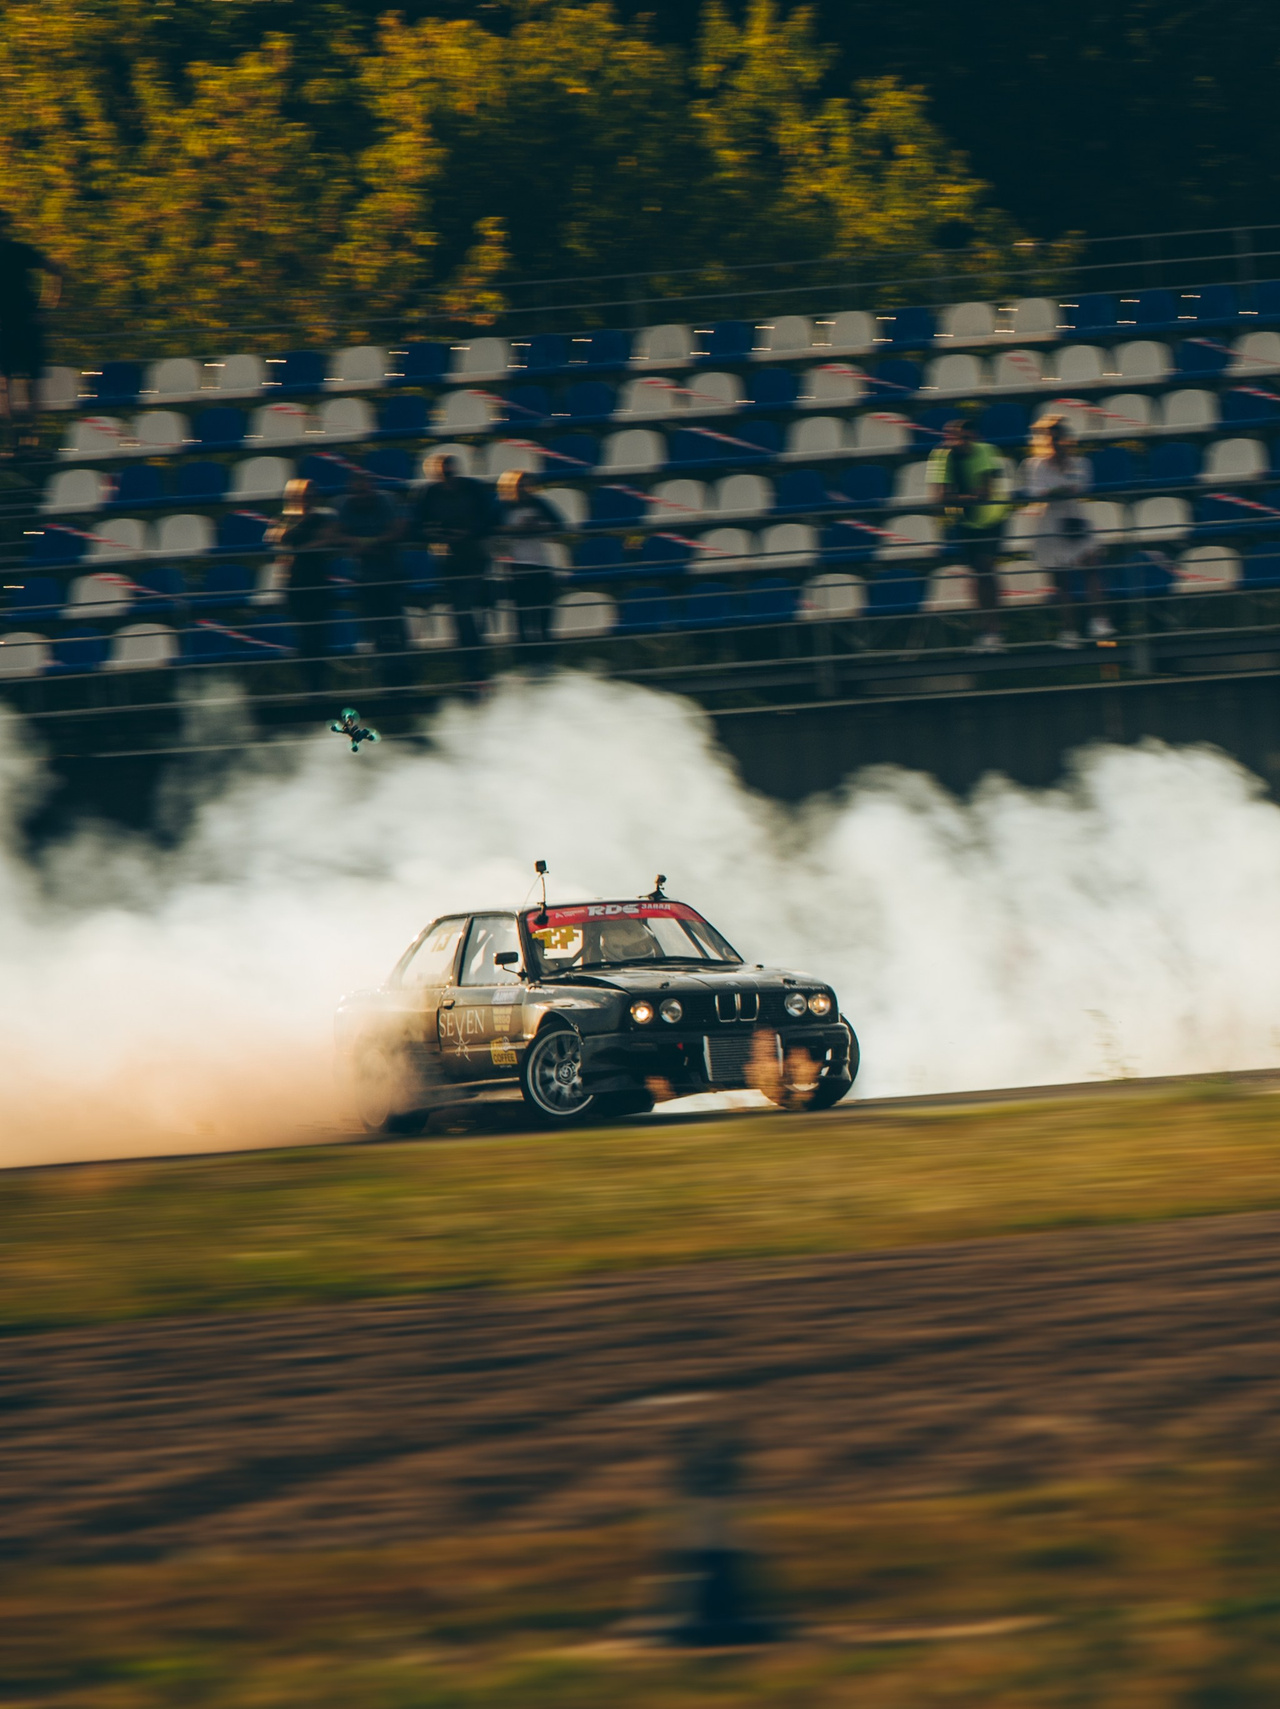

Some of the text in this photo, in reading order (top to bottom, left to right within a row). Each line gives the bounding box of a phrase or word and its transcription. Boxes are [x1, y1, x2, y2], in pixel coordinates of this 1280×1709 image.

[587, 904, 640, 917] RDS
[438, 1008, 486, 1040] SEVEN
[493, 1053, 516, 1063] COFFEE
